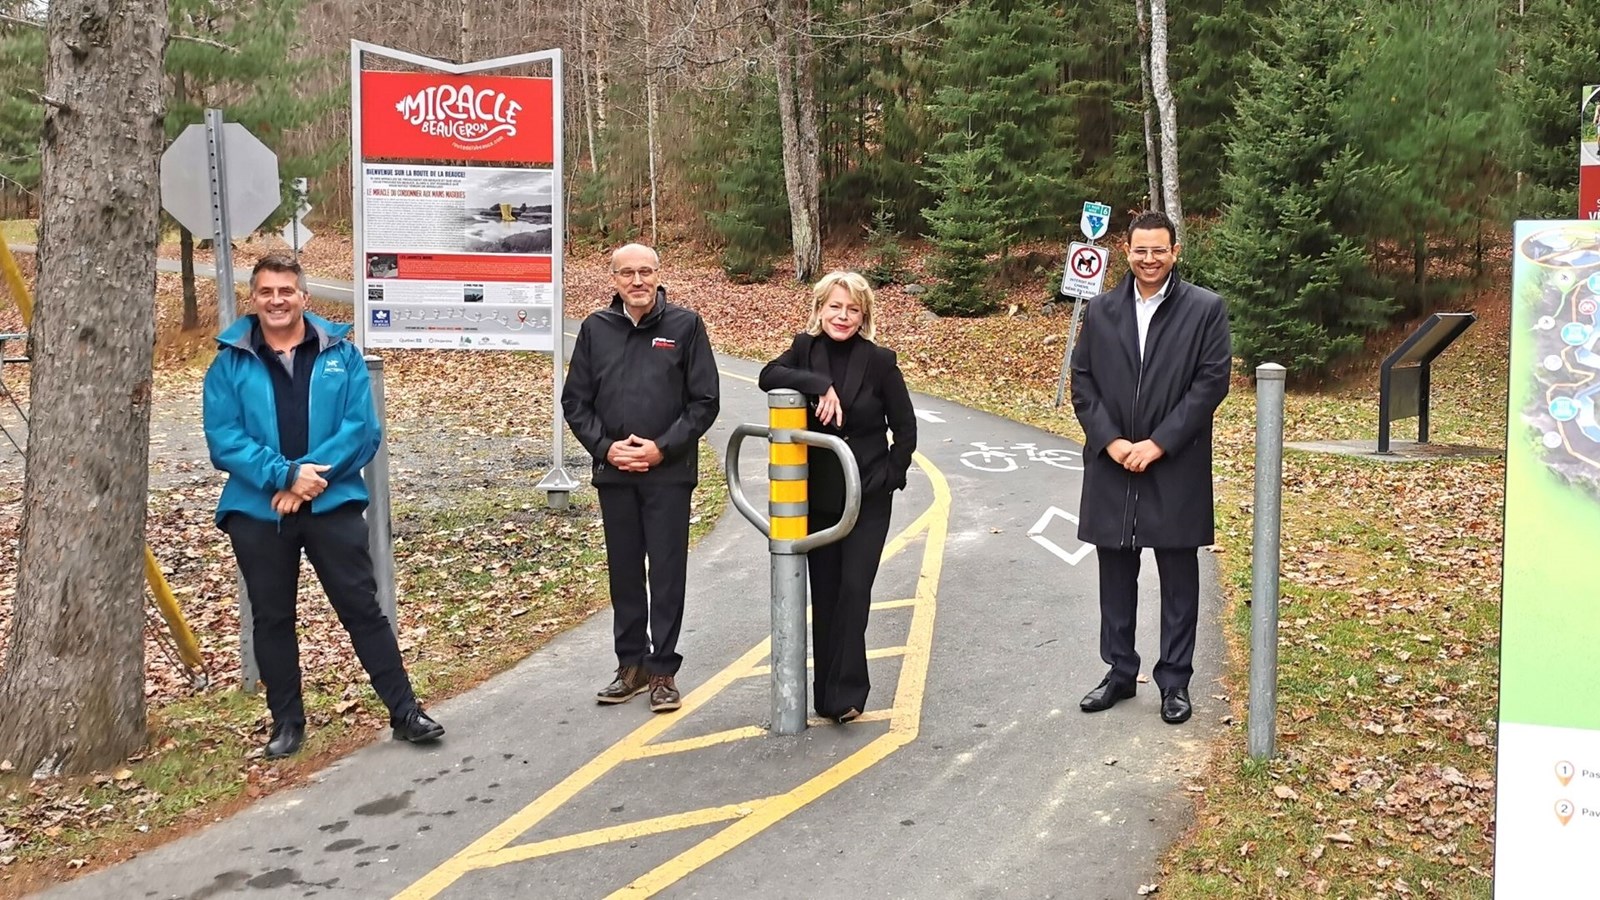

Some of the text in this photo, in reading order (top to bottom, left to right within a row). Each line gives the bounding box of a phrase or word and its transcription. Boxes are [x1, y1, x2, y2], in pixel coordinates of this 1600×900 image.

[403, 84, 522, 125] MIRACLE
[421, 120, 489, 139] BEAUCERON
[366, 168, 393, 176] BIENVENUE
[1562, 766, 1567, 774] 1
[1561, 804, 1568, 813] 2
